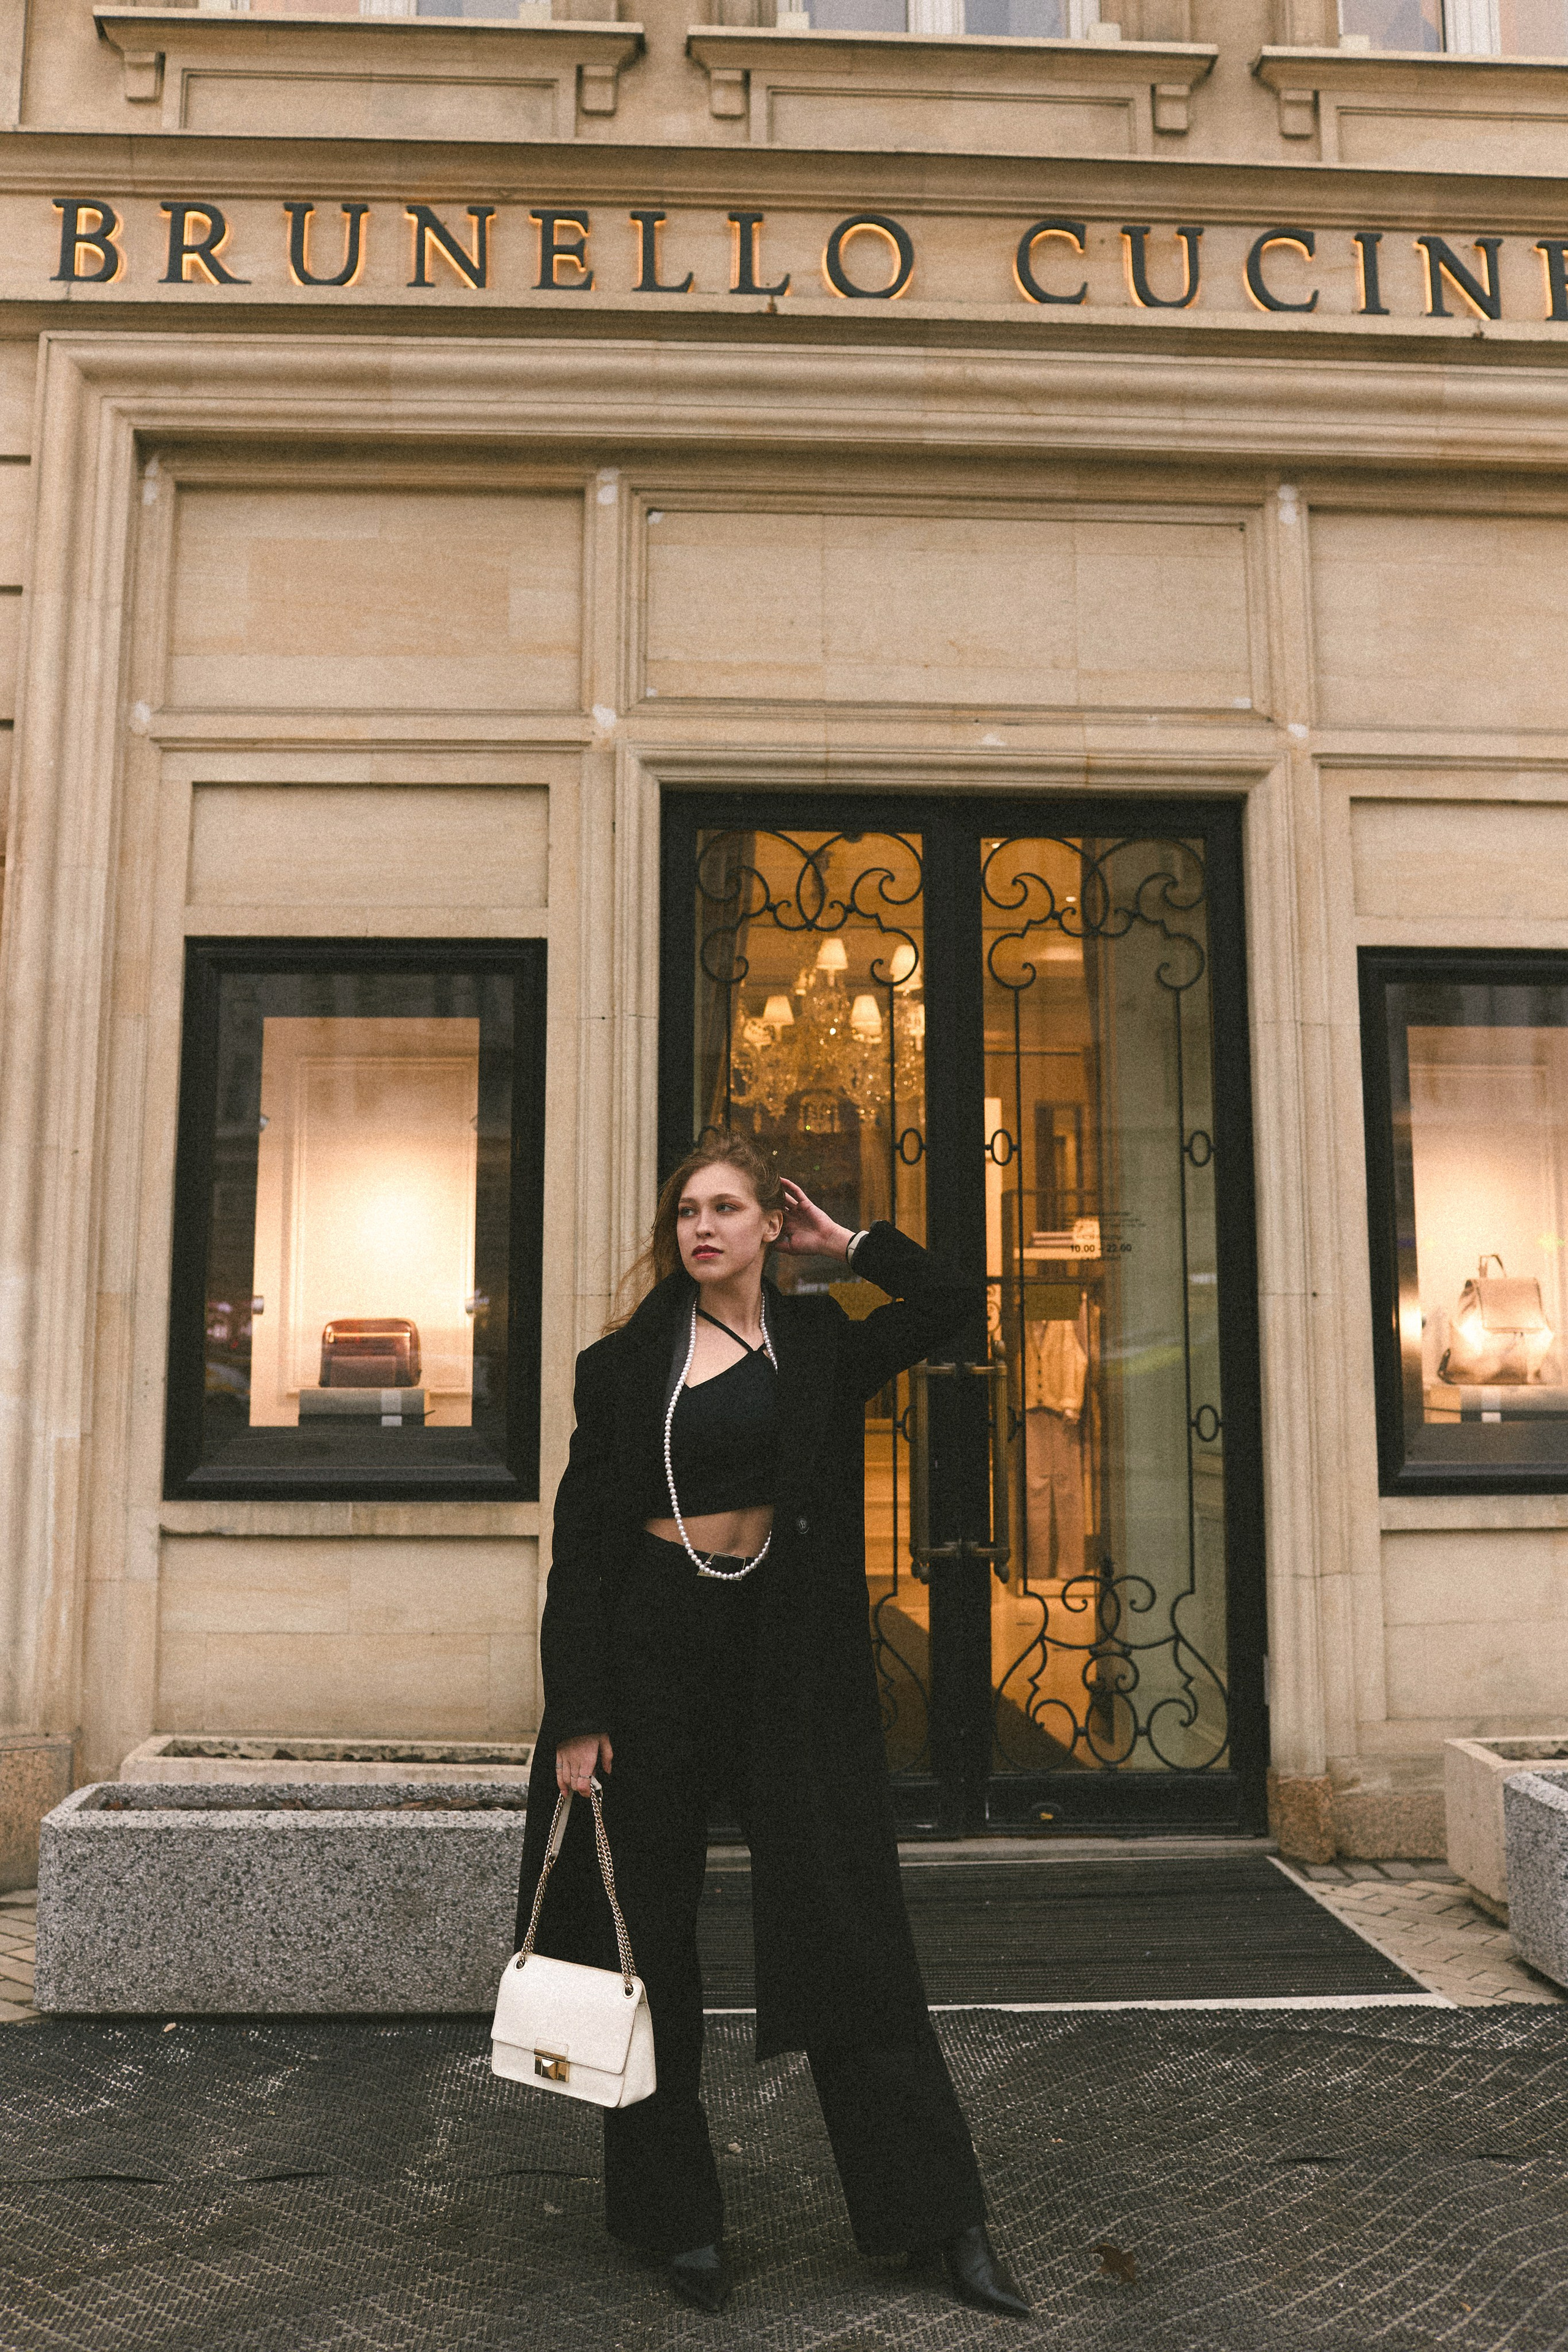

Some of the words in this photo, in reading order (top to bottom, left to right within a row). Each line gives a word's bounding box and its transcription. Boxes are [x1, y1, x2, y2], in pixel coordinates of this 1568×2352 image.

[50, 197, 915, 301] BRUNELLO
[1070, 1244, 1095, 1253] 10.00
[1107, 1243, 1132, 1253] 22.00
